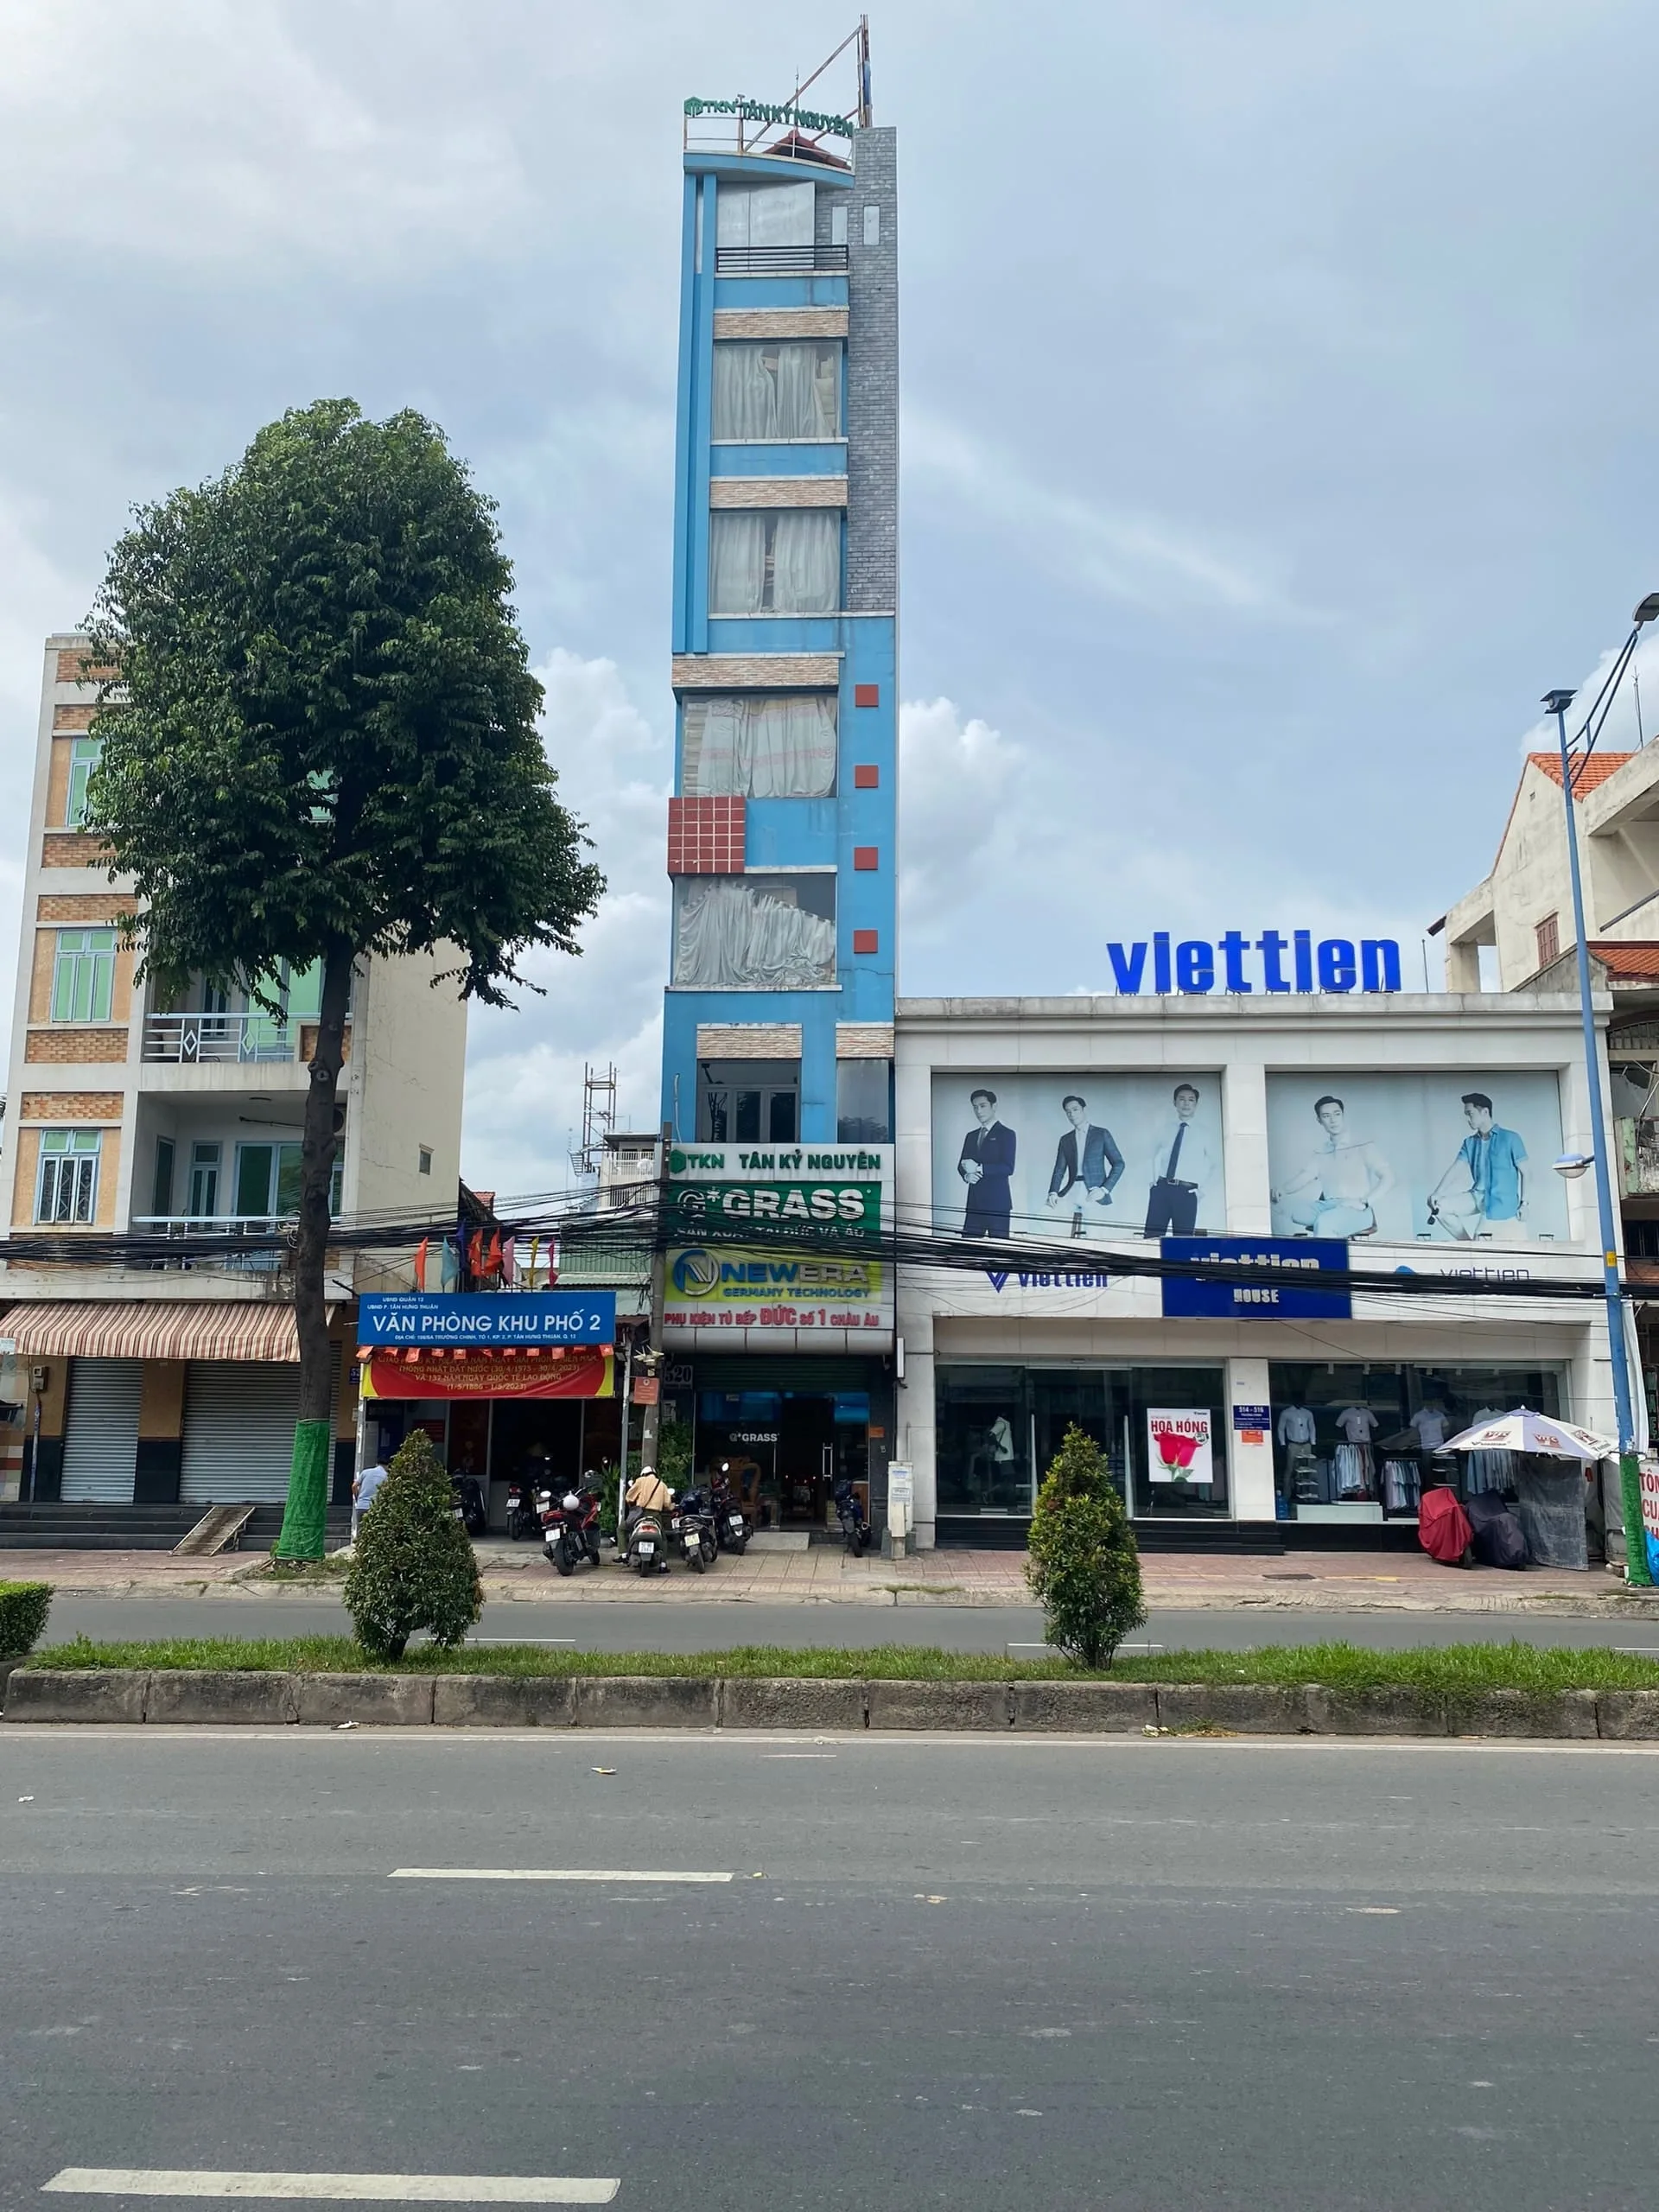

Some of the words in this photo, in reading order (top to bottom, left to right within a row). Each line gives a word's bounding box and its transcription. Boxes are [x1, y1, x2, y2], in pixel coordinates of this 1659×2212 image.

[1106, 930, 1402, 994] viettien
[687, 1154, 724, 1169] TKN
[739, 1151, 774, 1170] TÂN
[807, 1151, 881, 1170] NGUYÊN
[722, 1189, 864, 1219] GRASS
[723, 1287, 784, 1297] GERMANY
[788, 1287, 870, 1298] TECHNOLOGY
[1233, 1288, 1280, 1303] HOUSE
[372, 1312, 416, 1332] VĂN
[422, 1311, 493, 1332] PHÒNG
[499, 1315, 537, 1332] KHU
[544, 1308, 585, 1331] PHỐ
[589, 1314, 601, 1331] 2
[818, 1308, 826, 1325] 1
[742, 1433, 778, 1442] GRASS
